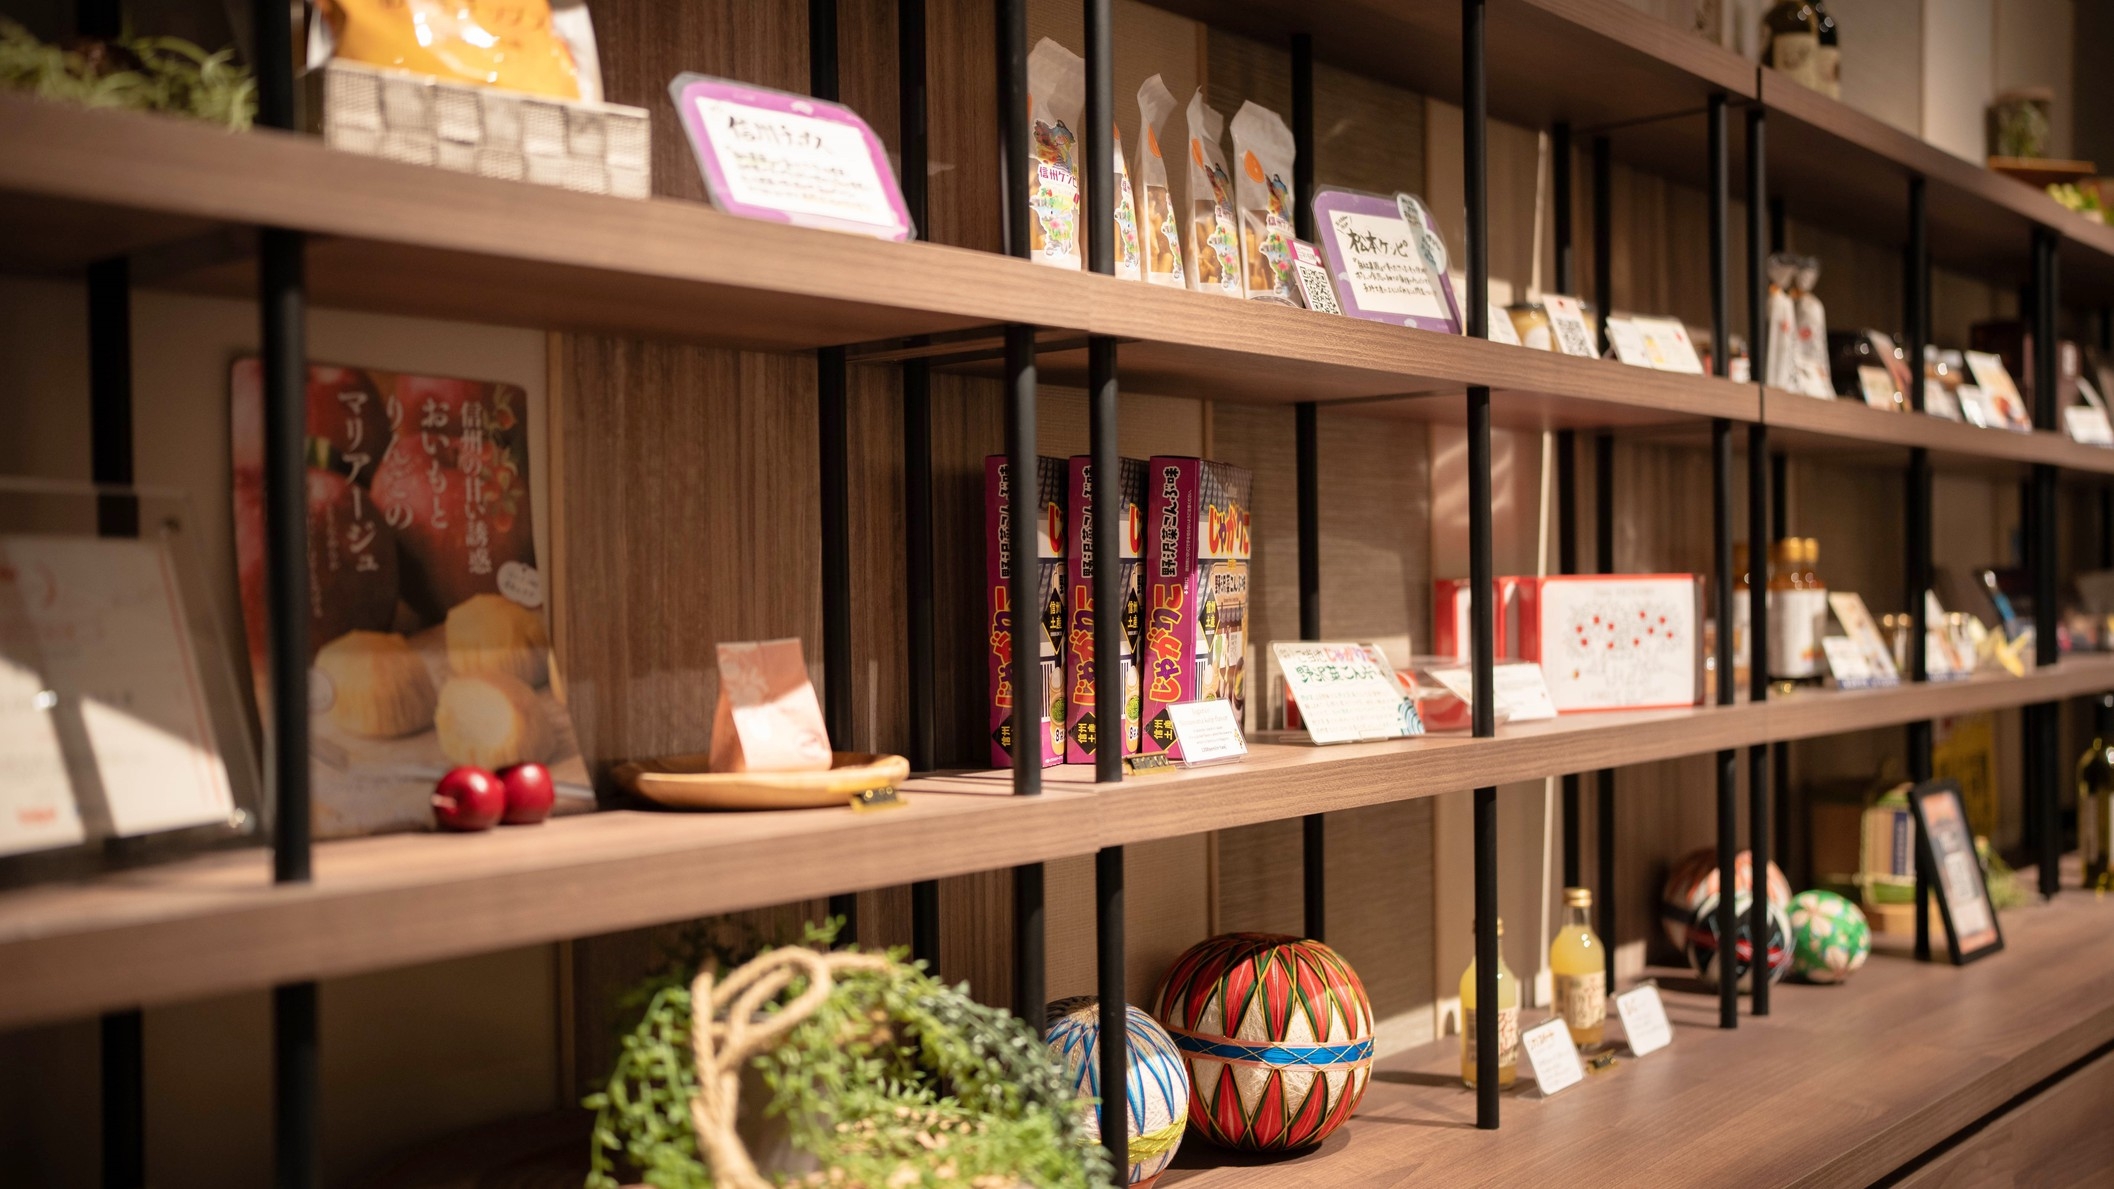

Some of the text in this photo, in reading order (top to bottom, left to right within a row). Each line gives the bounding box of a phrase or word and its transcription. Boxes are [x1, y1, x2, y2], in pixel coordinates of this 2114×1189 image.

[337, 391, 379, 572] マリアージュ
[383, 395, 414, 531] りんごの
[421, 396, 451, 530] おいもと
[458, 400, 492, 575] 信州の甘い誘惑
[1160, 466, 1180, 577] 野沢菜こんぶ味
[1208, 500, 1250, 557] じゃがりこ
[1147, 584, 1184, 702] じゃがりこ
[1001, 725, 1011, 746] 信州
[1077, 723, 1087, 743] 信州
[1153, 719, 1164, 740] 信州
